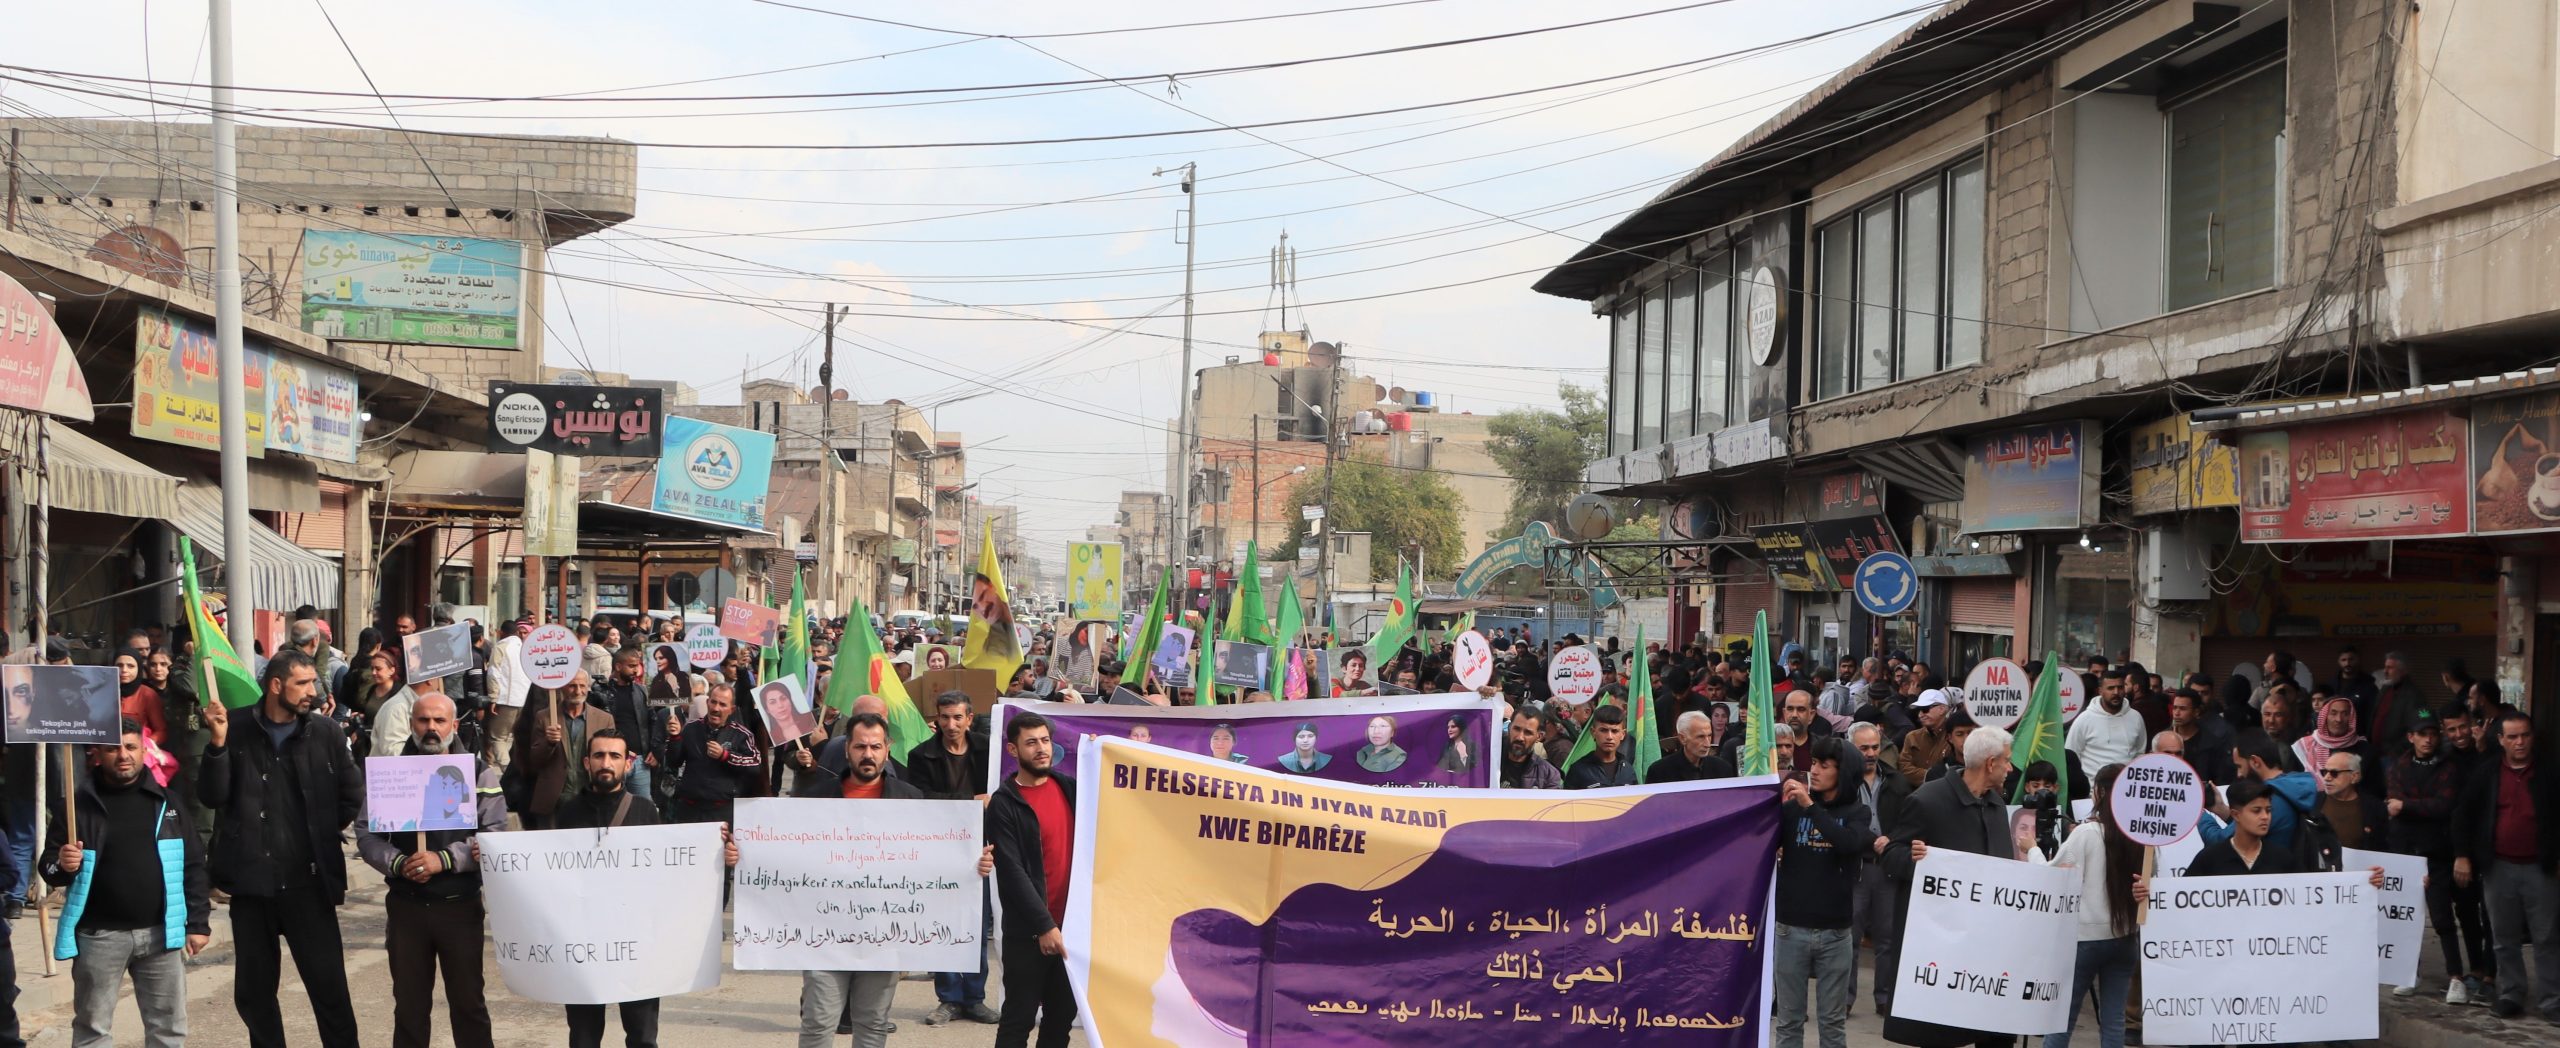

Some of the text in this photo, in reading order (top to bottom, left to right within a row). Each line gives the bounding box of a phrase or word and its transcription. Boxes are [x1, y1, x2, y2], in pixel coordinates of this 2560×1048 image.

[403, 274, 494, 288] للطاقة المتجددة
[1753, 307, 1775, 326] AZAD
[502, 403, 540, 411] NOKIA
[497, 415, 545, 425] Sony Ericsson
[2408, 424, 2457, 471] مكتب
[691, 464, 706, 474] AVA
[708, 466, 732, 479] ZELAL
[2296, 439, 2346, 490] العقاري
[662, 488, 692, 506] AVA
[695, 494, 737, 511] ZELAL
[725, 604, 752, 620] STOP
[528, 645, 548, 655] لوطن
[537, 671, 567, 680] النساء
[1986, 666, 2009, 685] NA
[1557, 684, 1594, 697] فيه النساء
[2006, 705, 2018, 716] RE
[2127, 766, 2193, 786] DESTÊ XWE
[1114, 764, 1448, 829] BI FELSEFEYA JIN JIYAN AZADÎ
[2139, 785, 2186, 803] BEDENA
[1199, 814, 1366, 854] XWE BIPARÊZE
[481, 846, 697, 872] EVERY WOMAN IS LIFE
[1922, 875, 1962, 900] BES
[1970, 883, 1982, 903] E
[2175, 886, 2296, 910] OCCUPATION
[2305, 886, 2323, 905] IS
[2335, 884, 2359, 905] THE
[1368, 897, 1454, 939] الحرية
[1584, 902, 1658, 944] المرأة
[1670, 906, 1756, 948] بفلسفة
[496, 941, 639, 963] WE ASK FOR LIFE
[2248, 935, 2329, 957] VIOLENCE
[1552, 957, 1622, 994] احمي
[1914, 962, 1939, 986] HÛ
[2211, 996, 2281, 1017] WOMEN
[2289, 995, 2329, 1015] AND
[2212, 1022, 2277, 1043] NATURE
